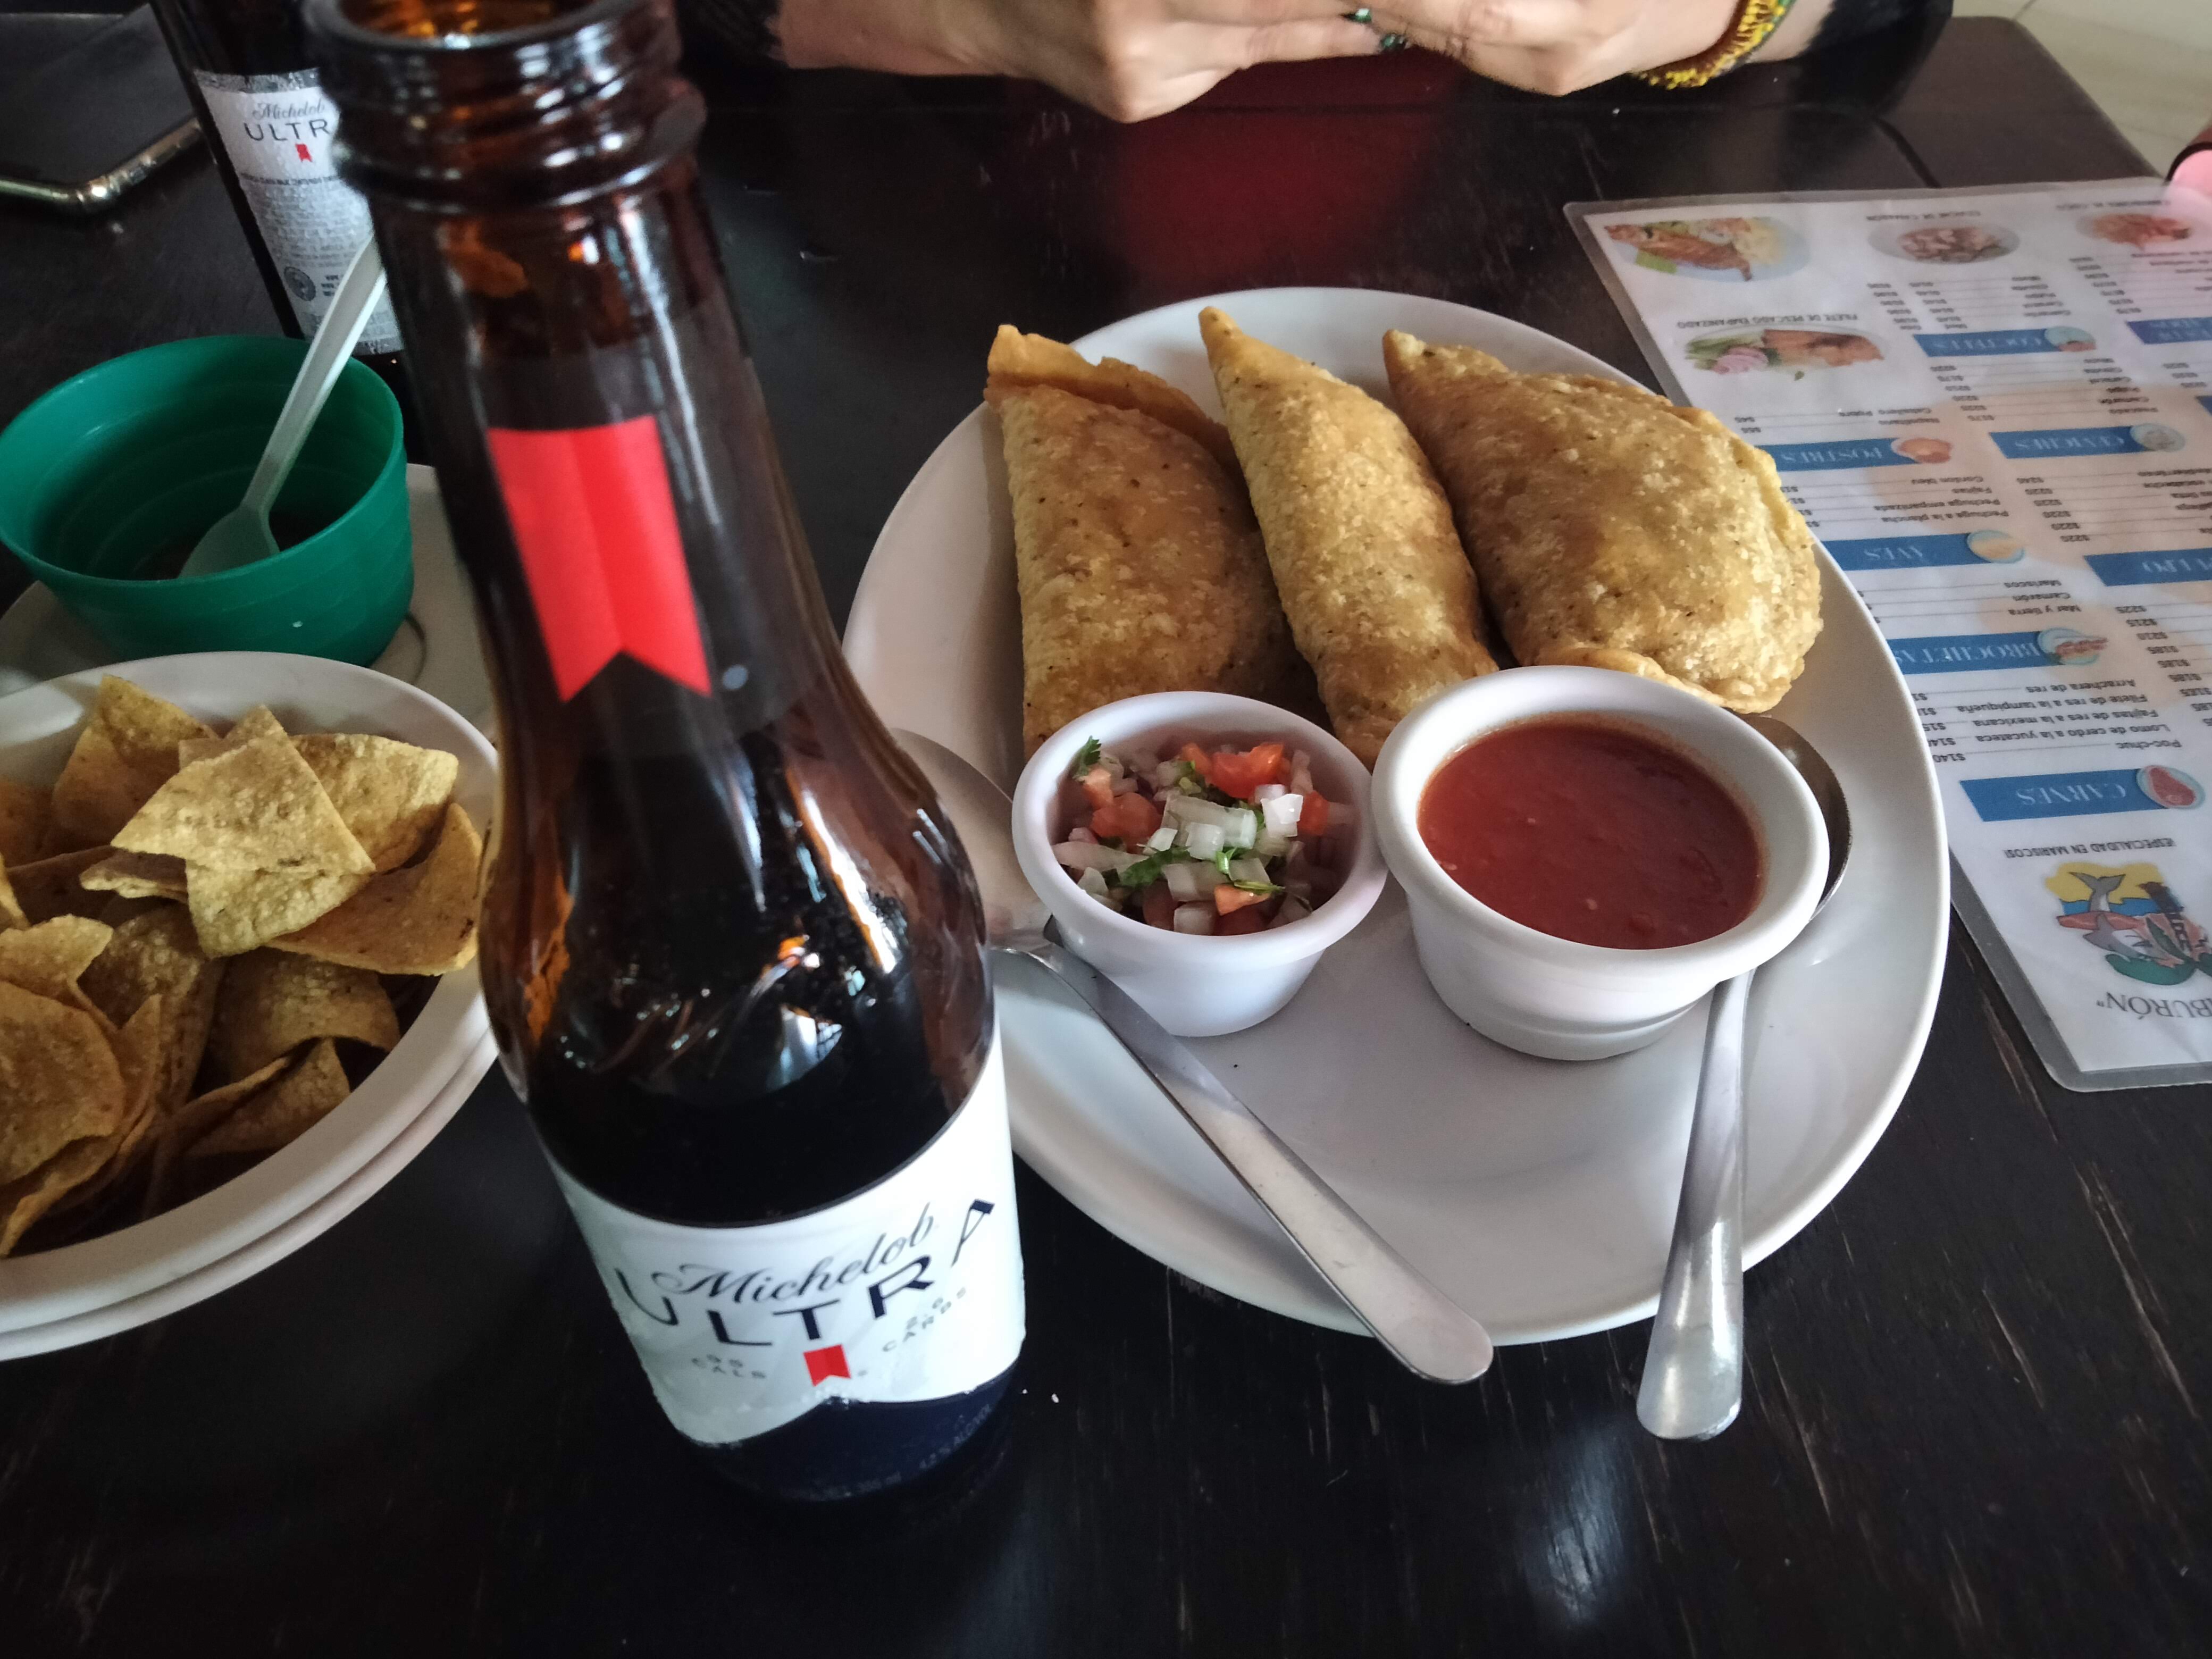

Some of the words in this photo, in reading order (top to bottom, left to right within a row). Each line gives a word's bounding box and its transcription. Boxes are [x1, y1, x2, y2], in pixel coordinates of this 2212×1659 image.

[252, 98, 325, 120] Michelob
[242, 119, 331, 142] ULTR
[1780, 447, 1882, 464] POSTRES
[1864, 546, 1923, 560] AVES
[2142, 558, 2212, 573] ULPO
[2069, 679, 2135, 690] Arrachera
[2089, 697, 2107, 706] de
[2108, 694, 2148, 703] Filete
[1955, 701, 2037, 714] tampiqueña
[2111, 708, 2159, 718] Fajitas
[2040, 716, 2055, 724] la
[2091, 712, 2110, 720] de
[1922, 722, 1947, 732] $15
[1972, 717, 2038, 727] mexicana
[2067, 727, 2107, 738] cerdo
[2109, 726, 2127, 735] de
[2129, 724, 2171, 733] Lomo
[1975, 730, 2038, 742] yucateca
[2115, 739, 2183, 750] Poc-chuc
[1932, 752, 1966, 763] $140
[2014, 782, 2127, 806] CARNES
[2071, 844, 2088, 855] EN
[2096, 991, 2212, 1021] BURÓN"
[652, 1202, 936, 1305] Michelob
[615, 1198, 995, 1347] ULTRA
